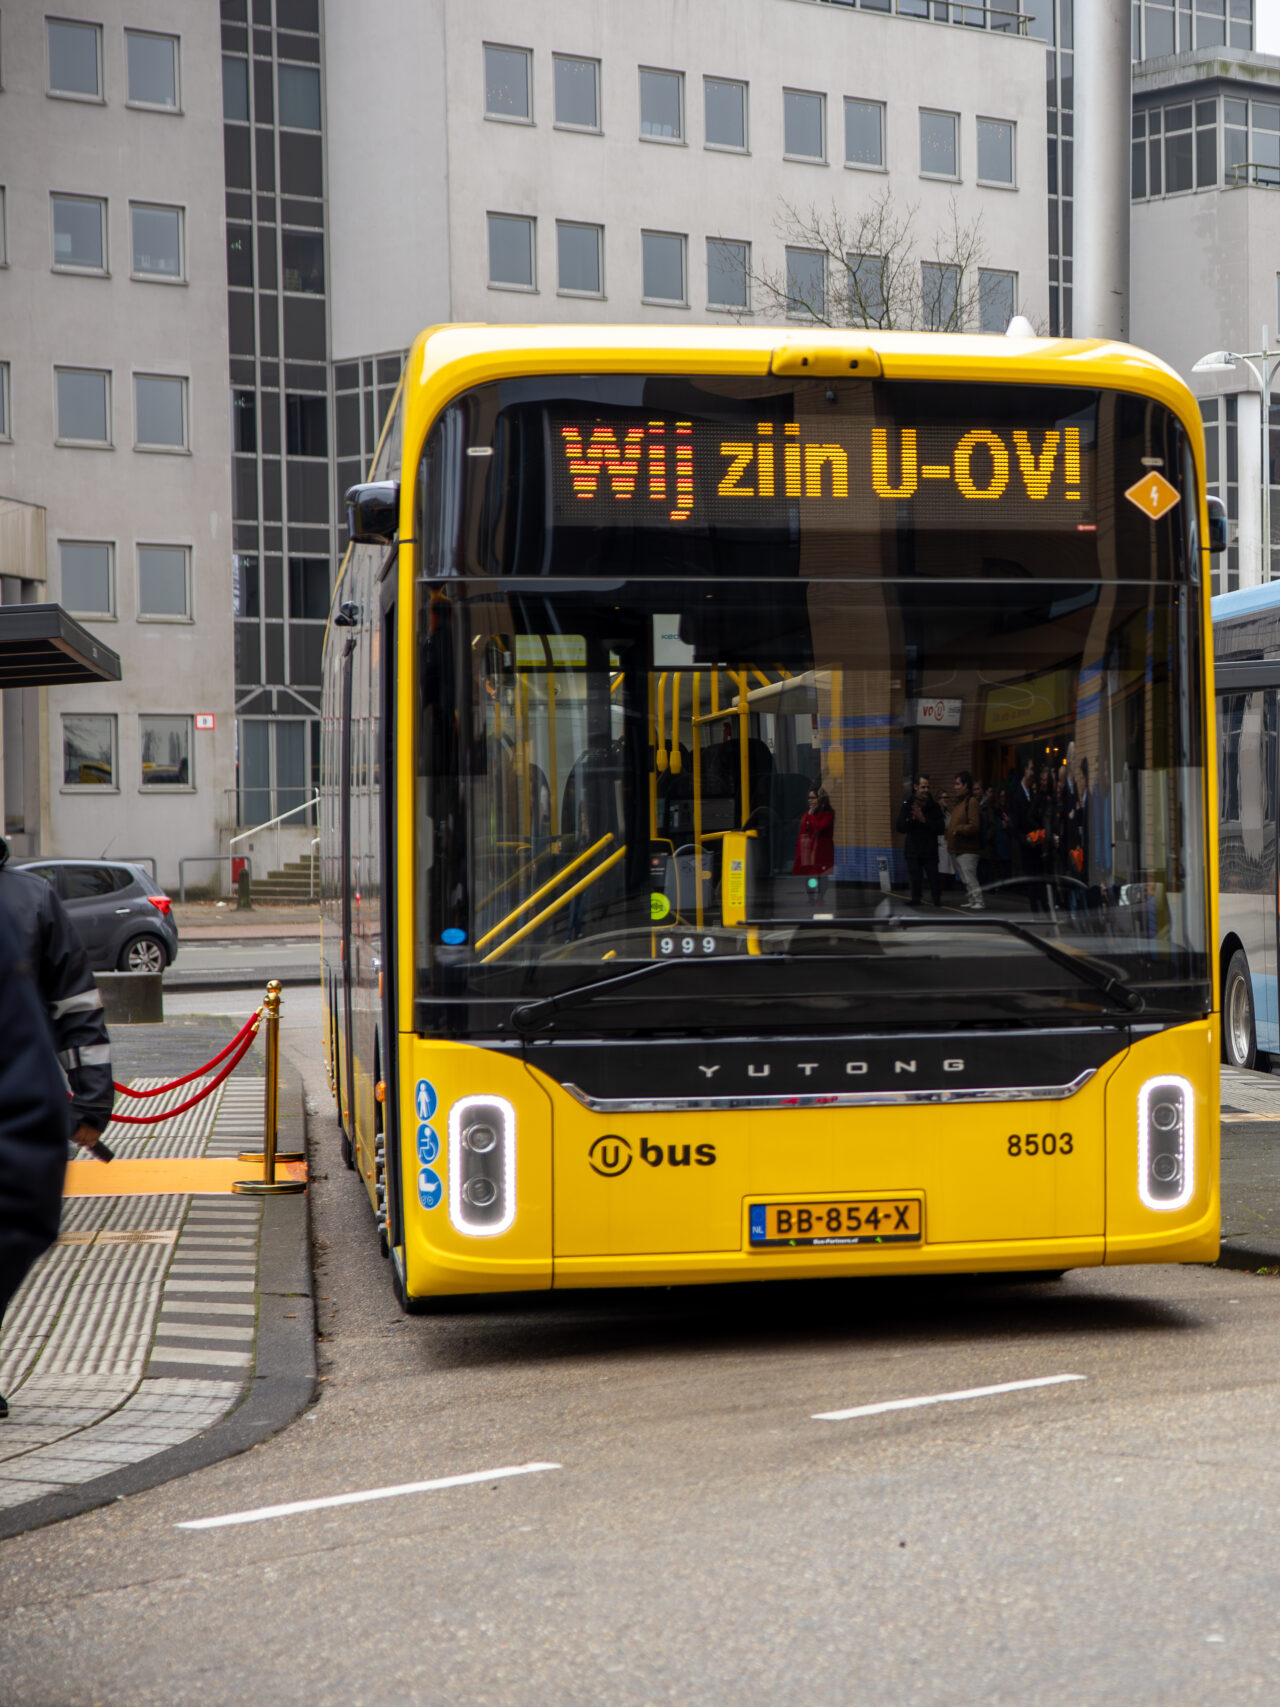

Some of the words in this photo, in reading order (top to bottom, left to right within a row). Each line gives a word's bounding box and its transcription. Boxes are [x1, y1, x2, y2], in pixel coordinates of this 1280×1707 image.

[561, 420, 693, 520] Wij
[870, 427, 1082, 500] U-OV!
[660, 937, 715, 954] 999
[698, 1058, 965, 1078] YUTONG
[1007, 1132, 1074, 1157] 8503
[752, 1225, 764, 1234] NL
[776, 1205, 910, 1234] BB-854-X
